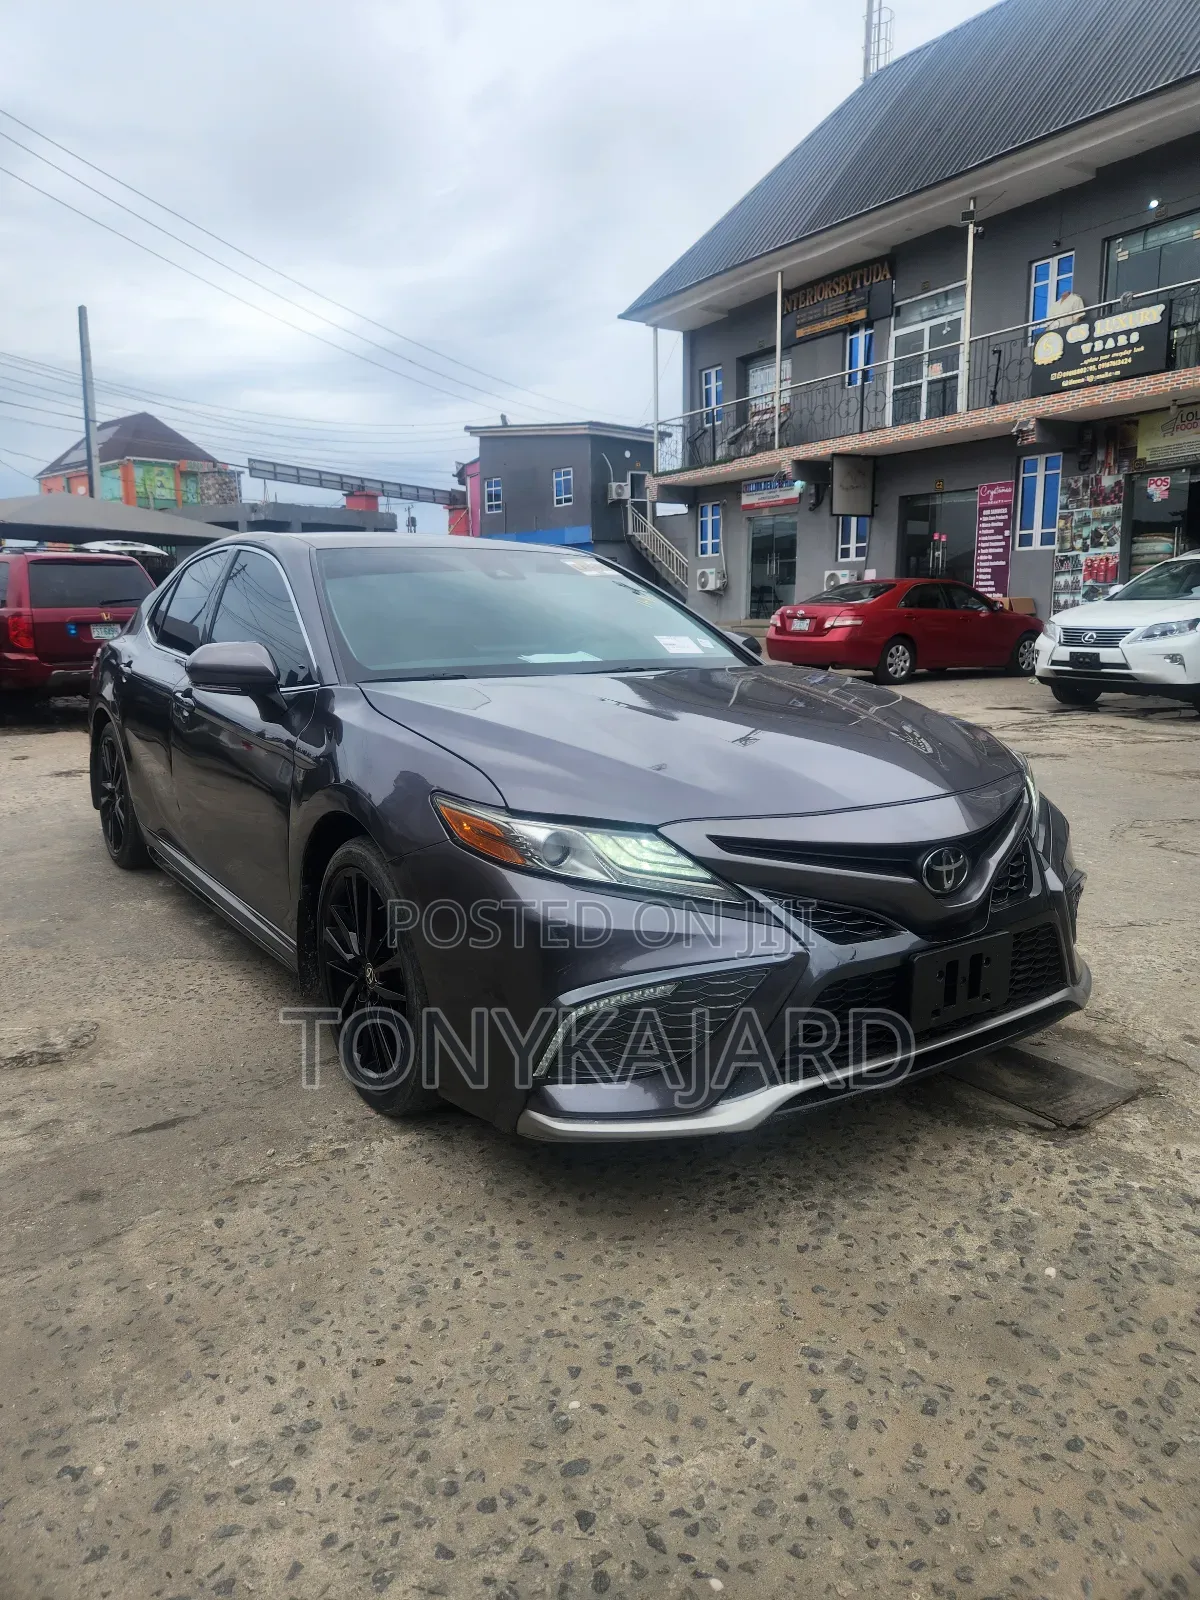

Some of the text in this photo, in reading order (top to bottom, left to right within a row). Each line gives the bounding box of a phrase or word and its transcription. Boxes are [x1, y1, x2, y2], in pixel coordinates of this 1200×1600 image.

[783, 260, 892, 315] NTERIORSBYTUDA
[1094, 303, 1166, 338] LUXURY
[1175, 421, 1199, 432] FOOD
[1148, 477, 1170, 487] POS
